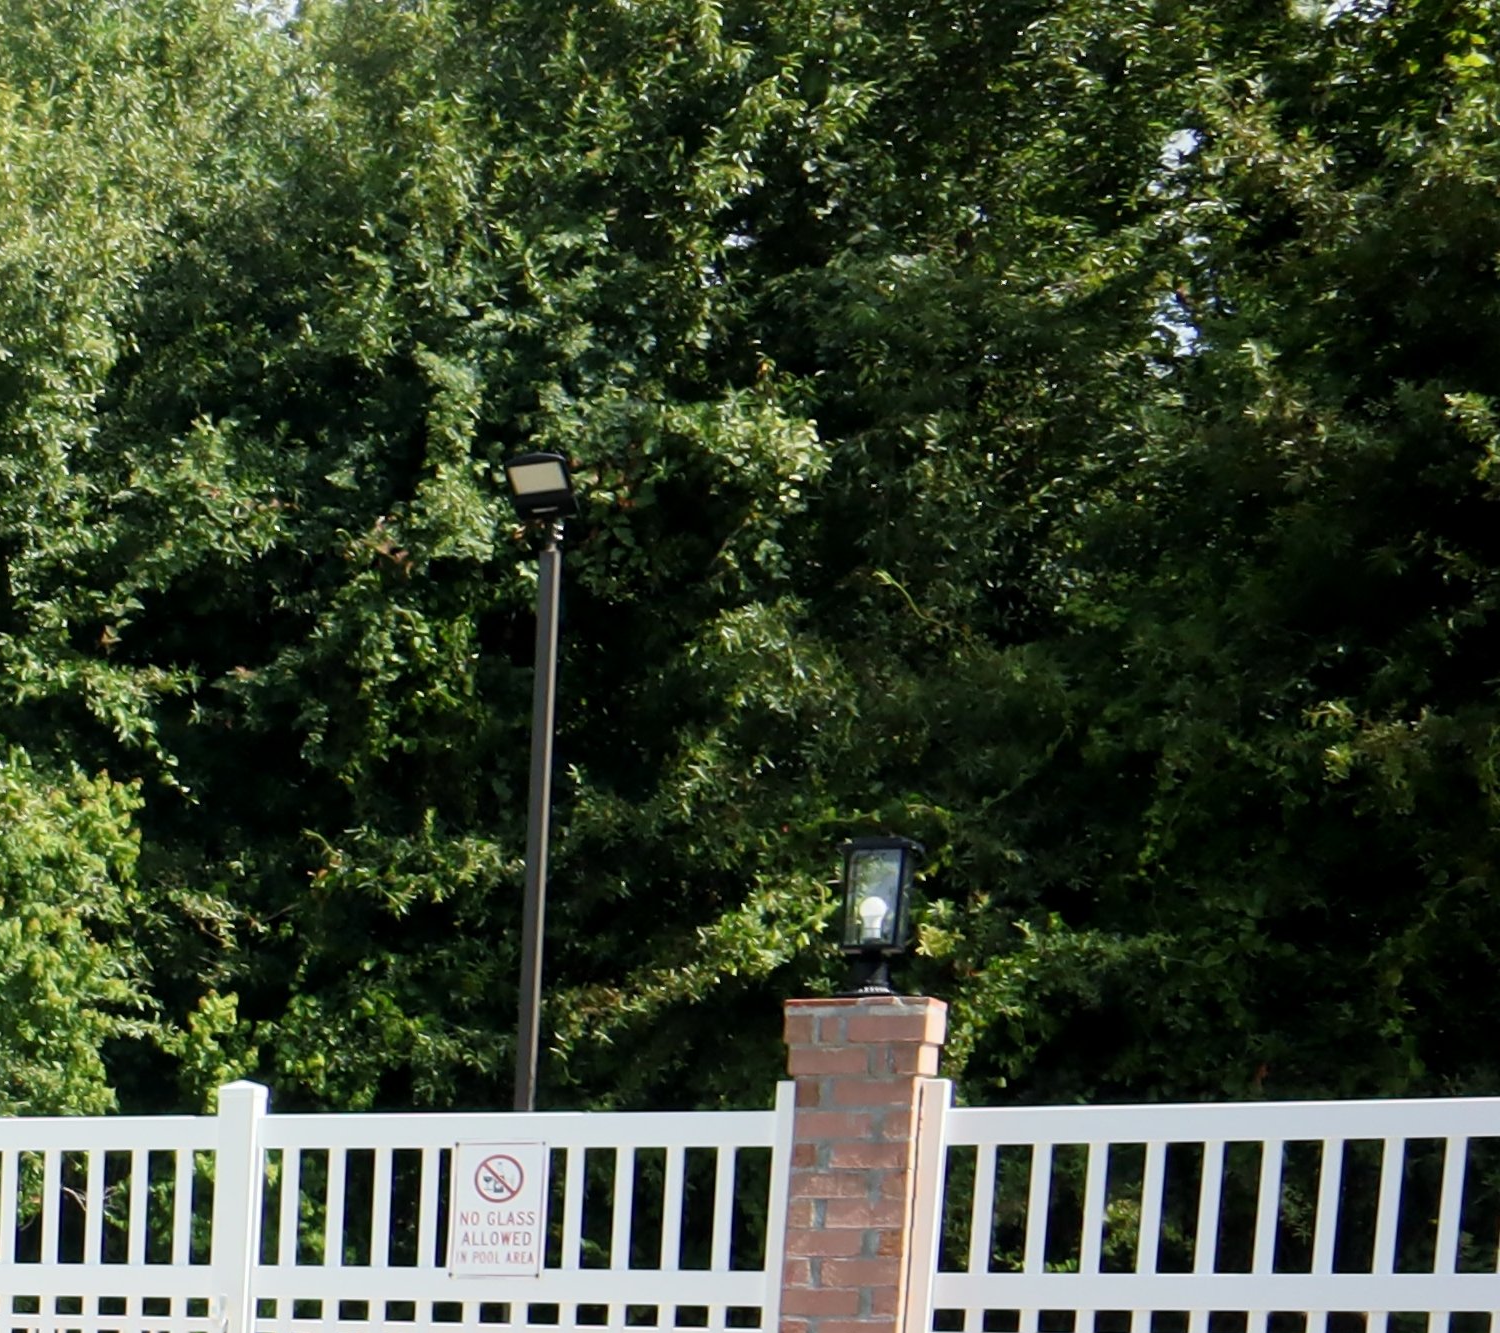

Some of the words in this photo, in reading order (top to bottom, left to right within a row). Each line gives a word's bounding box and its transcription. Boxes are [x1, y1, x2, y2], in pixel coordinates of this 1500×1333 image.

[460, 1211, 480, 1226] NO
[487, 1211, 535, 1226] GLASS
[462, 1231, 533, 1246] ALLOWED
[455, 1252, 468, 1264] IN
[472, 1251, 500, 1264] POOL
[506, 1251, 535, 1264] AREA
